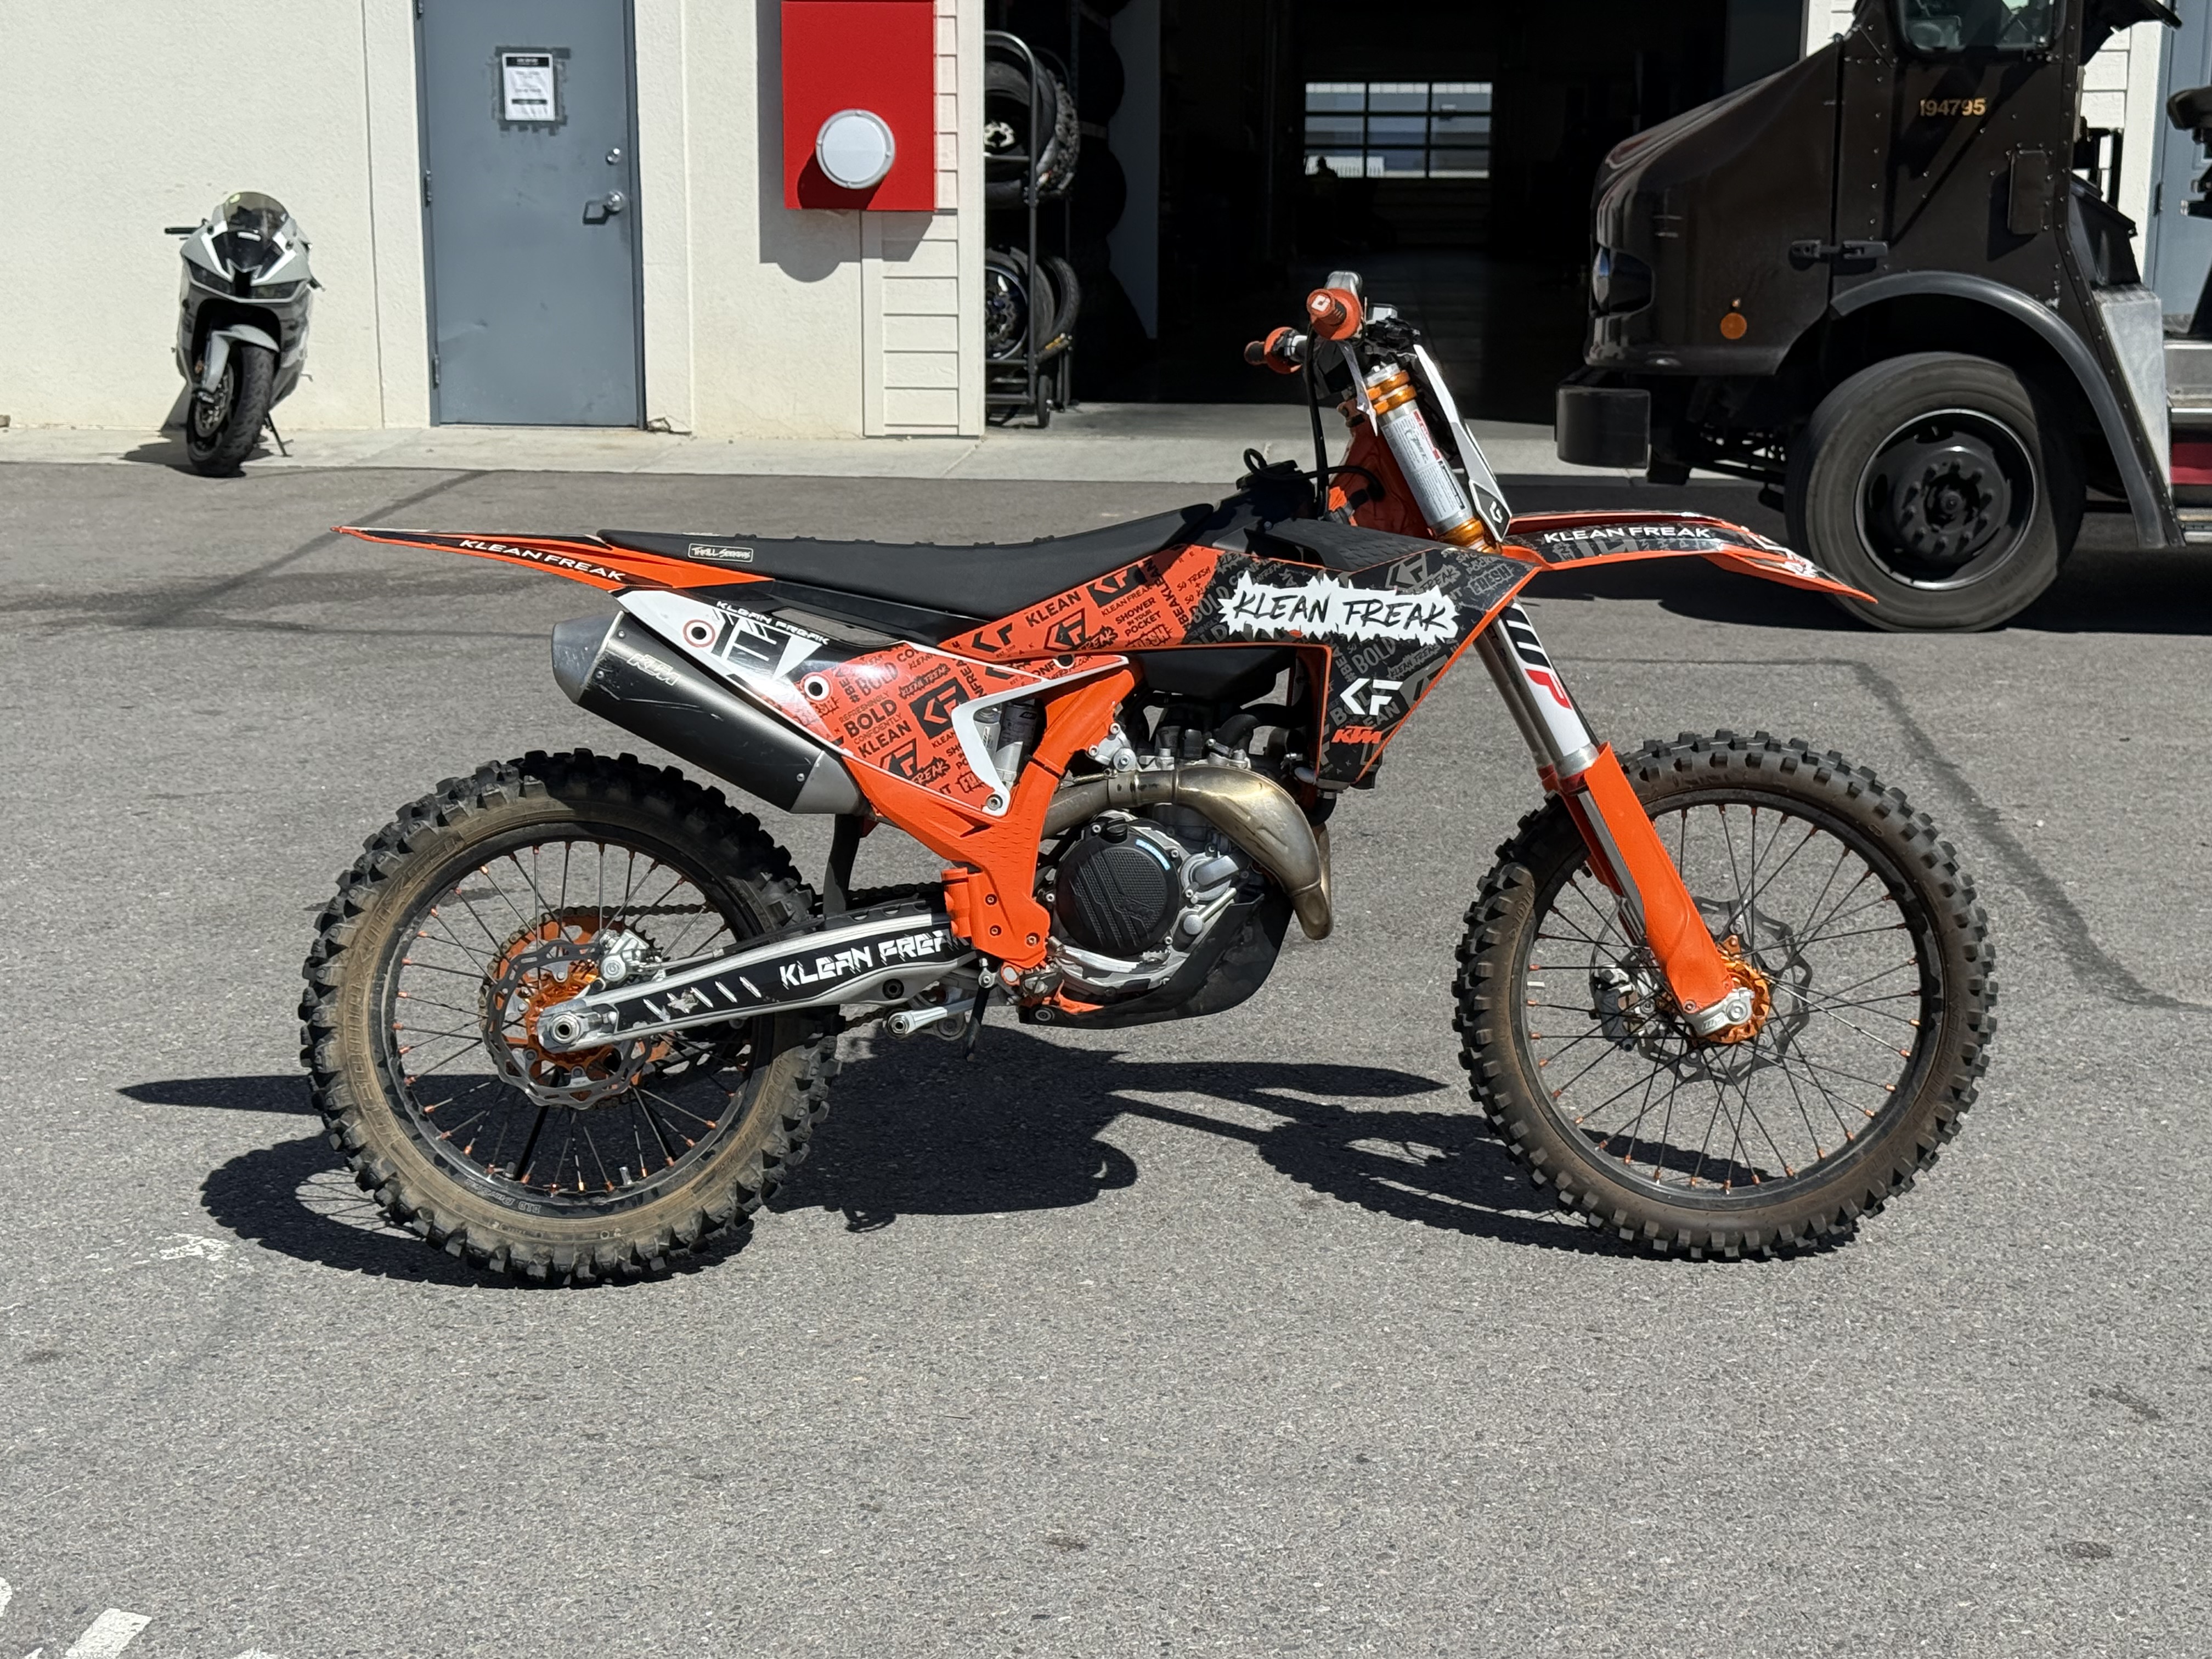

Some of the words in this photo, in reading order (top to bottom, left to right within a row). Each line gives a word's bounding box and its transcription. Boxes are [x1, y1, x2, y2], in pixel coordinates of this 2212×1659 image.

[1921, 98, 1986, 116] 194795
[1544, 527, 1625, 543] KLEAN
[1628, 527, 1711, 538] FREAK
[459, 539, 543, 561] KLEAN
[544, 553, 626, 581] FREAK
[1025, 591, 1082, 628] KLEAN
[1101, 597, 1127, 617] KLEAN
[1127, 586, 1153, 604] FREAK
[1115, 597, 1156, 624] SHOWER
[1135, 610, 1152, 621] YOUR
[1233, 590, 1331, 623] KLEAN
[1342, 599, 1448, 631] FREAK
[1125, 611, 1161, 636] POCKET
[627, 653, 681, 686] KTM
[1351, 637, 1396, 674] BOLD
[839, 691, 890, 723] REFRESHINGLY
[844, 699, 897, 738] BOLD
[854, 713, 903, 745] CONFIDENTLY
[858, 720, 912, 759] KLEAN
[1331, 725, 1383, 744] KTM
[780, 946, 873, 990] KLEAN
